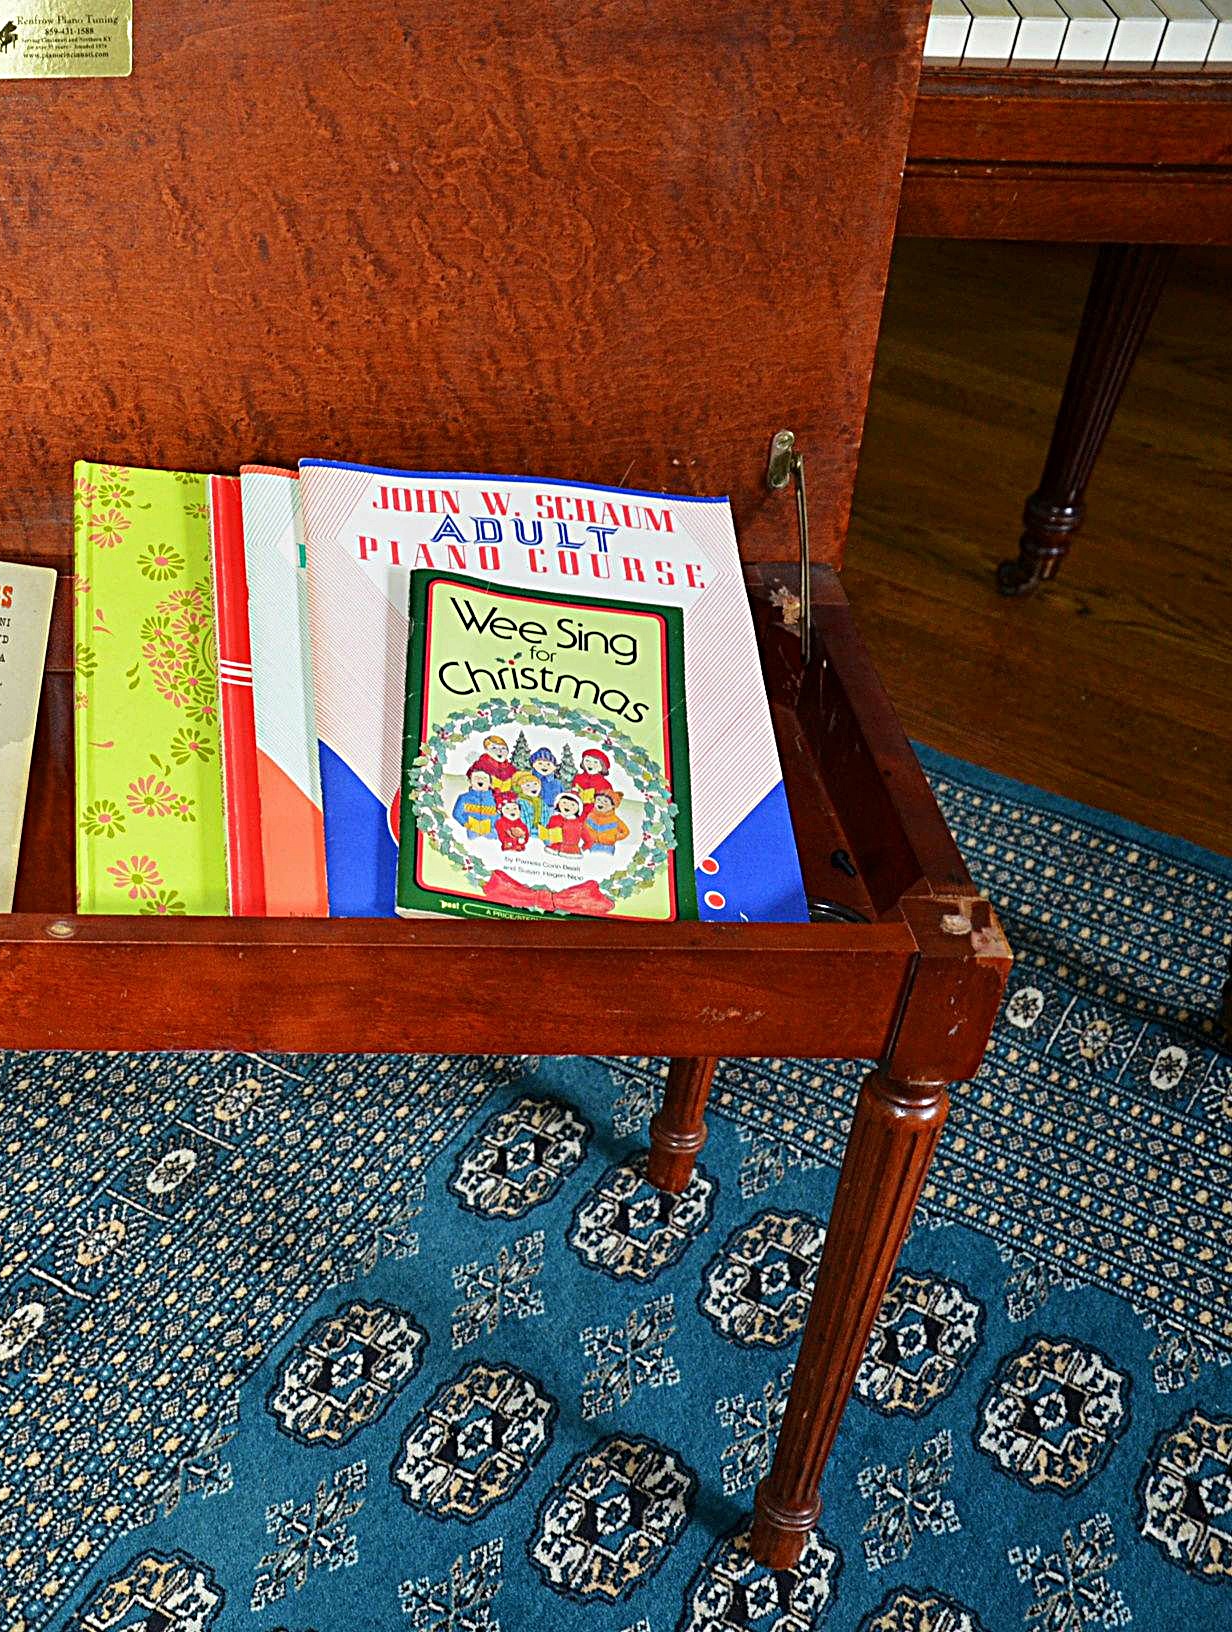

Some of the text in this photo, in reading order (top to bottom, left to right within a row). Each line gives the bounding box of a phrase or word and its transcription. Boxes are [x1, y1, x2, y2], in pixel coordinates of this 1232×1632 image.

[17, 14, 119, 25] Renfrow Piano Tuning
[45, 27, 94, 35] 859-431-1588
[372, 485, 676, 533] JOHN W. SCHAUM
[431, 514, 620, 553] ADULT
[356, 535, 706, 589] PIANO COURSE
[450, 597, 637, 666] Wee Sing
[529, 645, 557, 663] for
[438, 660, 650, 723] Christmas
